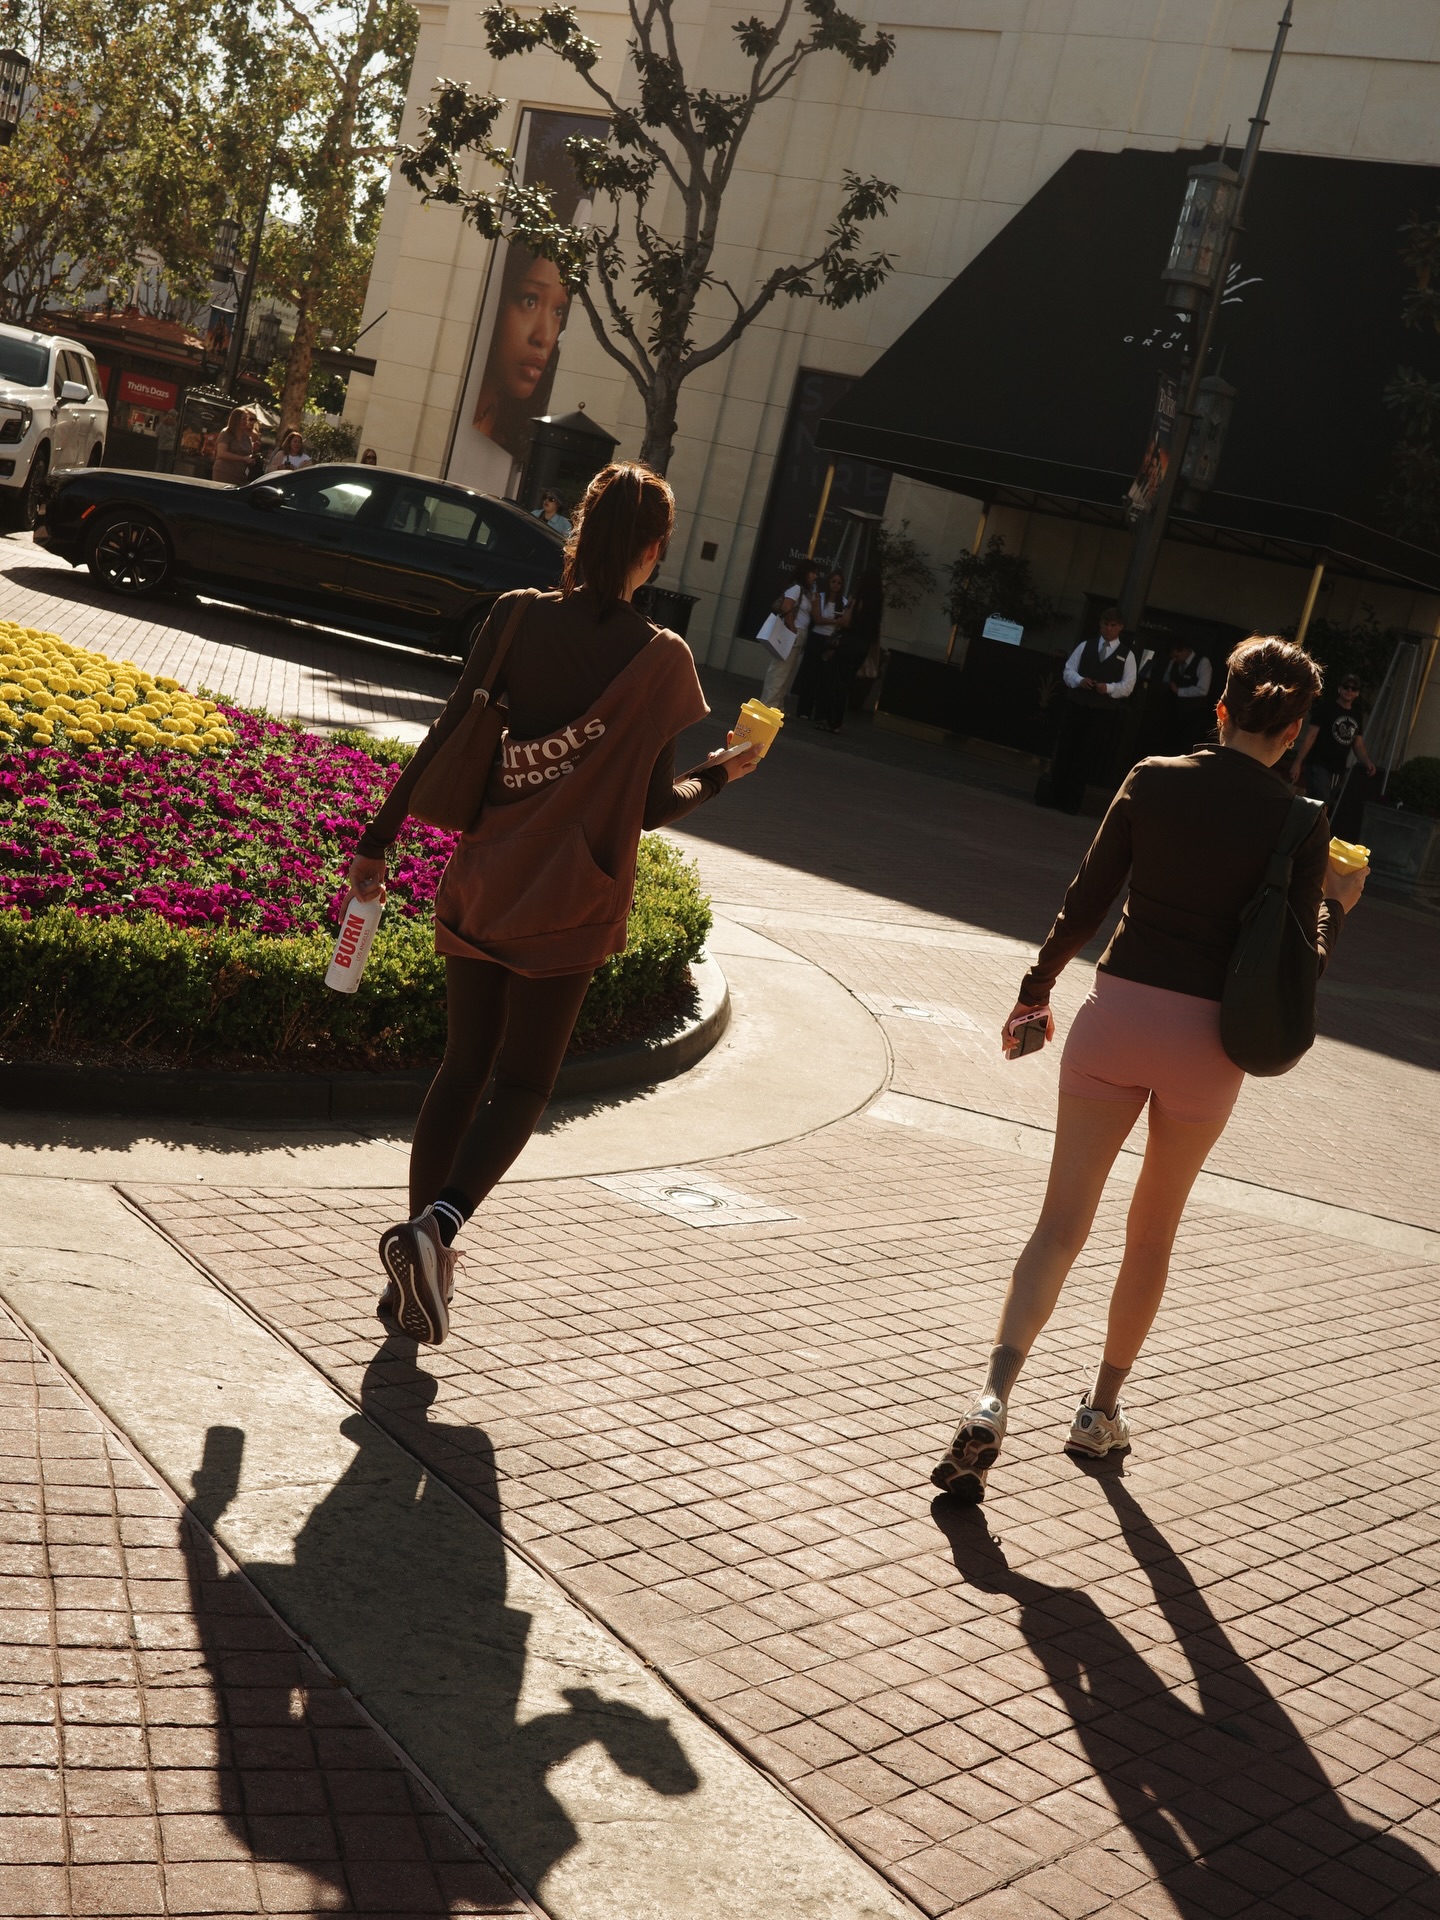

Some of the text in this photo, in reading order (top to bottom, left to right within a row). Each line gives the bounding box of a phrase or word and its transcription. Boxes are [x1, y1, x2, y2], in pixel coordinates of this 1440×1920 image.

[1152, 329, 1182, 340] TH
[150, 387, 169, 399] Dazs
[334, 913, 366, 969] BURN
